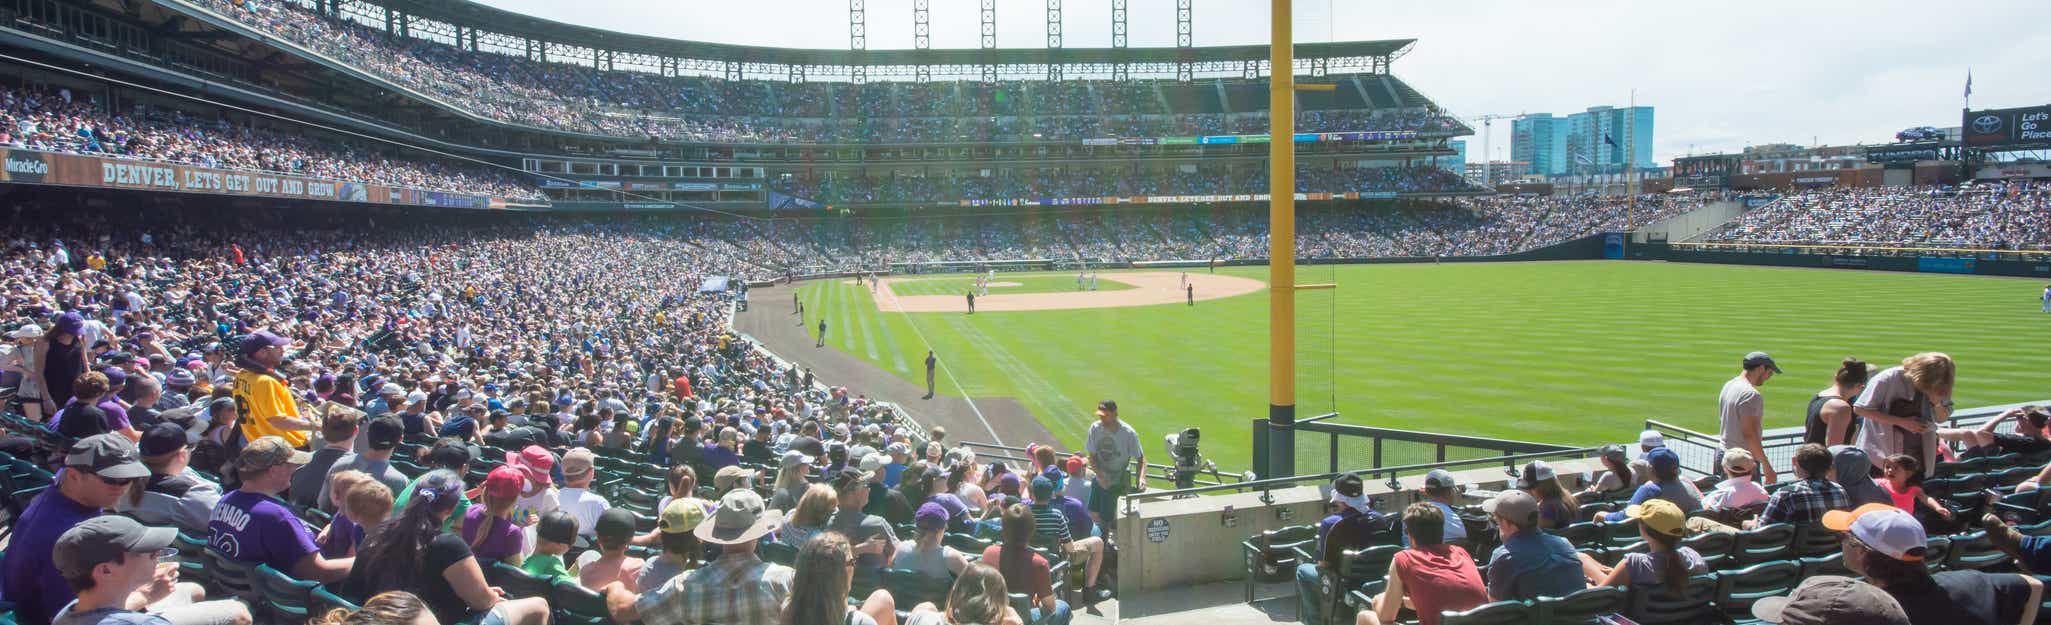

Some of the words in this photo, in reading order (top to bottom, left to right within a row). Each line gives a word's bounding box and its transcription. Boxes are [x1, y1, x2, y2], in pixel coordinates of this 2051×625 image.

[2022, 112, 2049, 121] Let's
[2021, 121, 2037, 130] Go
[102, 162, 180, 190] DENVER,
[226, 174, 250, 192] GET
[256, 177, 279, 193] OUT
[282, 179, 303, 195] AND
[308, 182, 334, 196] GROW
